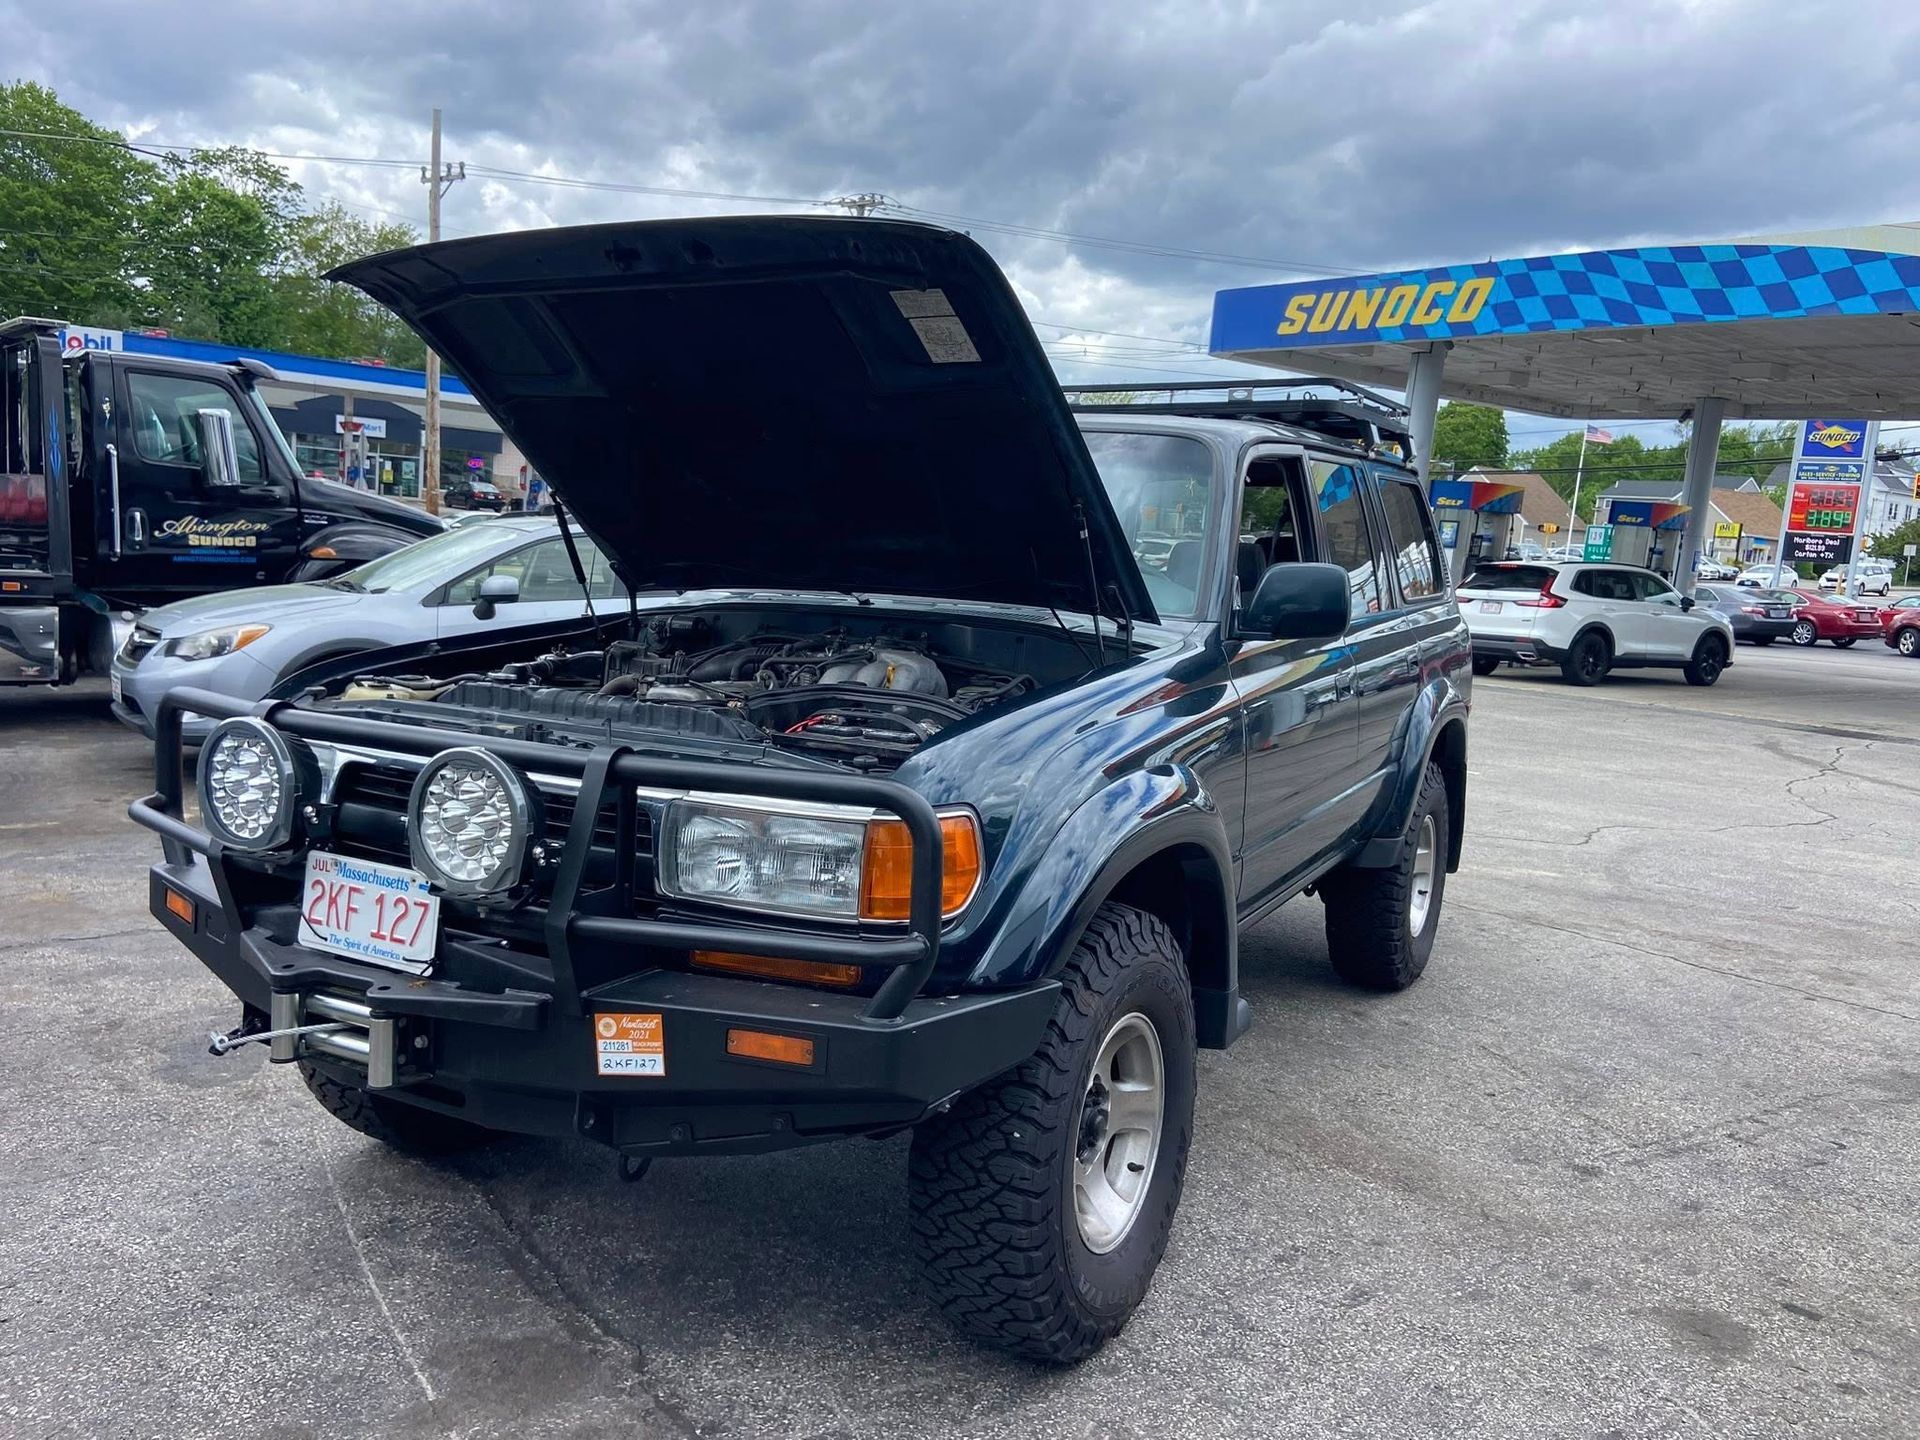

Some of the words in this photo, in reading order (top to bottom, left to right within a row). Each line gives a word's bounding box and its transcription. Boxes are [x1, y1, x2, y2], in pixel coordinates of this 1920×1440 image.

[1276, 277, 1496, 336] SUNOCO
[1810, 432, 1859, 442] SUNOCO
[154, 515, 270, 538] Abington
[188, 534, 257, 547] SUNOCO
[1793, 536, 1823, 545] Marlboro
[1825, 538, 1840, 546] Deal
[1794, 550, 1817, 558] Carton
[312, 858, 331, 873] JUL
[336, 862, 410, 892] Massachusetts
[307, 878, 366, 932] 2KF
[369, 891, 431, 948] 127
[329, 933, 342, 945] The
[343, 936, 362, 950] Spirit
[362, 941, 371, 953] of
[370, 944, 401, 961] America
[628, 1029, 650, 1040] 2021
[602, 1041, 630, 1051] 211281
[603, 1058, 657, 1070] 2KF127
